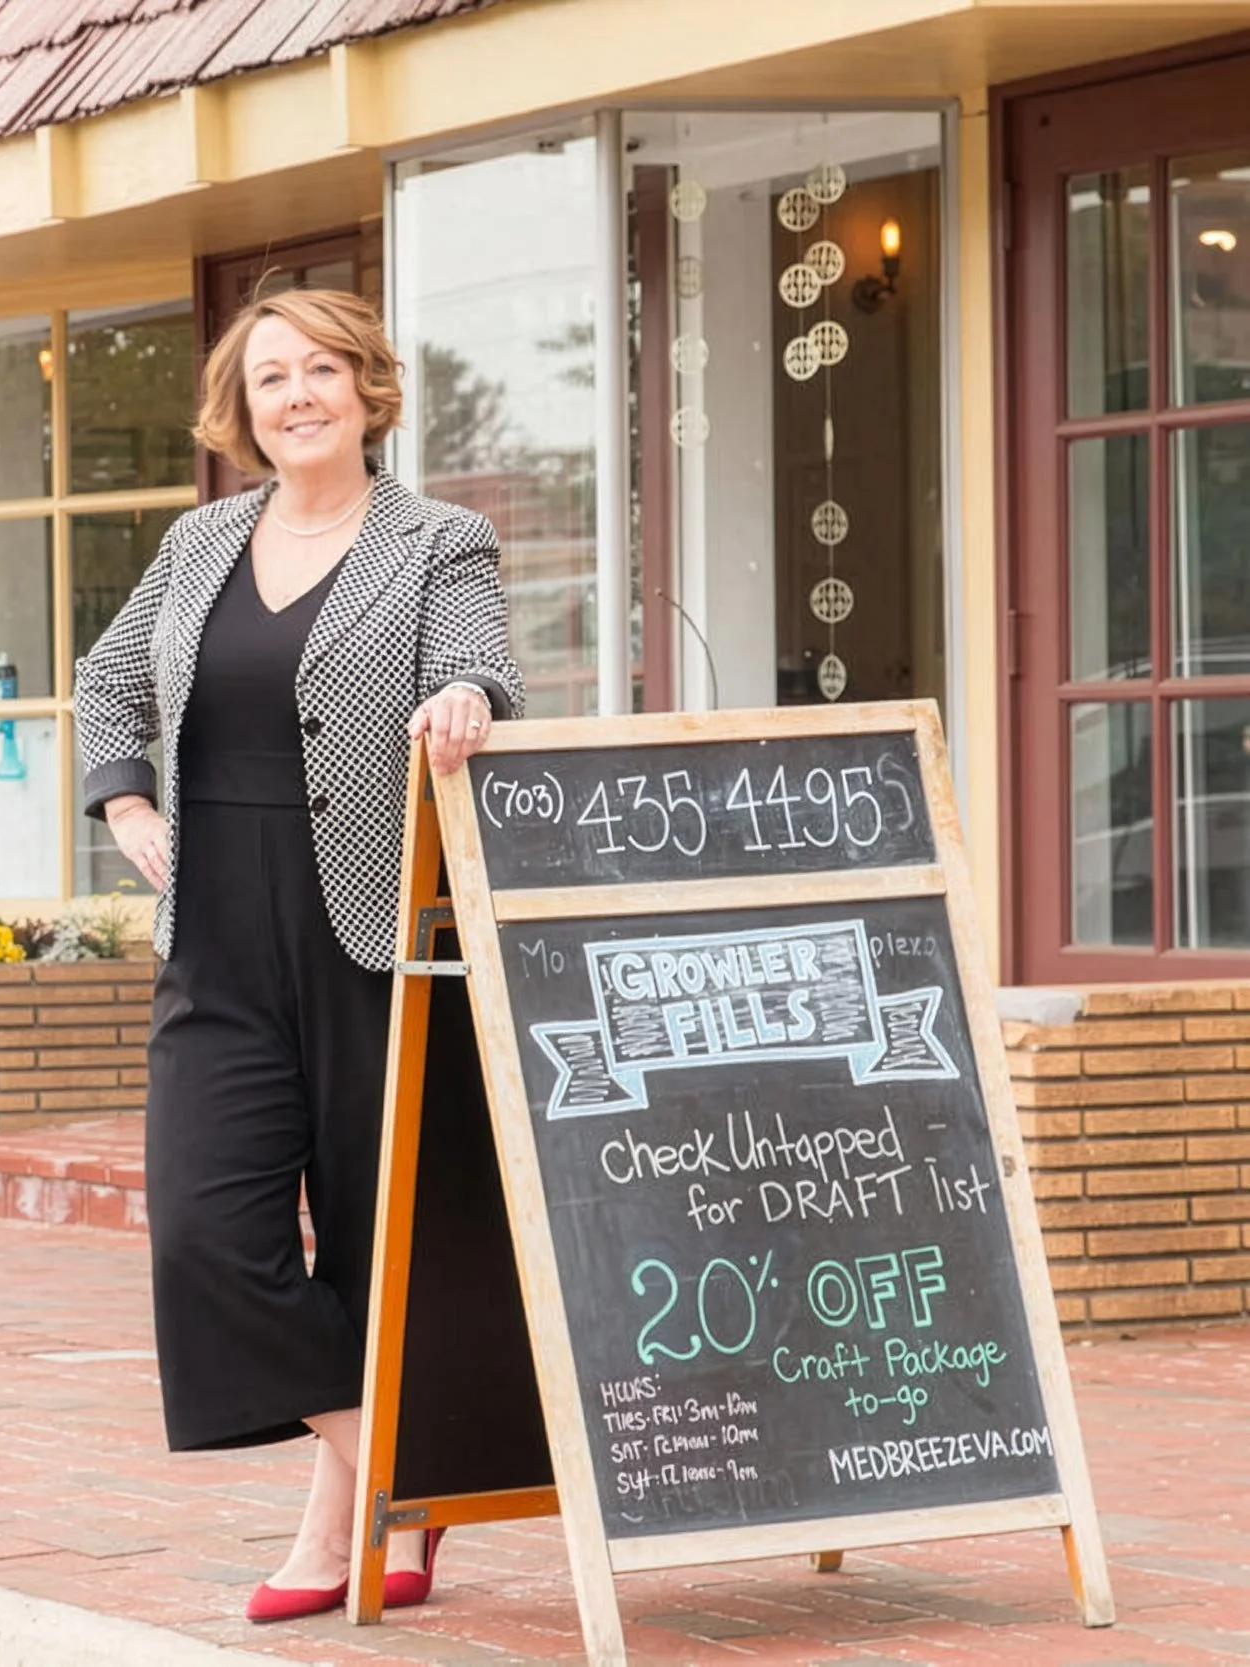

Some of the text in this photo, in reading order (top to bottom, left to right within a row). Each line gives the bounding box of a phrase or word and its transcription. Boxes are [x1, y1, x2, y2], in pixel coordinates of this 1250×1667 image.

[480, 769, 564, 829] (703)
[576, 769, 707, 857] 435
[608, 939, 823, 1001] GROWLER
[662, 990, 818, 1059] FILLS
[726, 1105, 905, 1184] Untapped
[686, 1182, 744, 1232] for
[760, 1164, 913, 1224] DRAFT
[631, 1245, 947, 1365] 20% OFF
[772, 1337, 1008, 1387] Craft Package
[844, 1386, 929, 1425] to-go
[828, 1425, 1054, 1485] MEDBREEZEVA.COM
